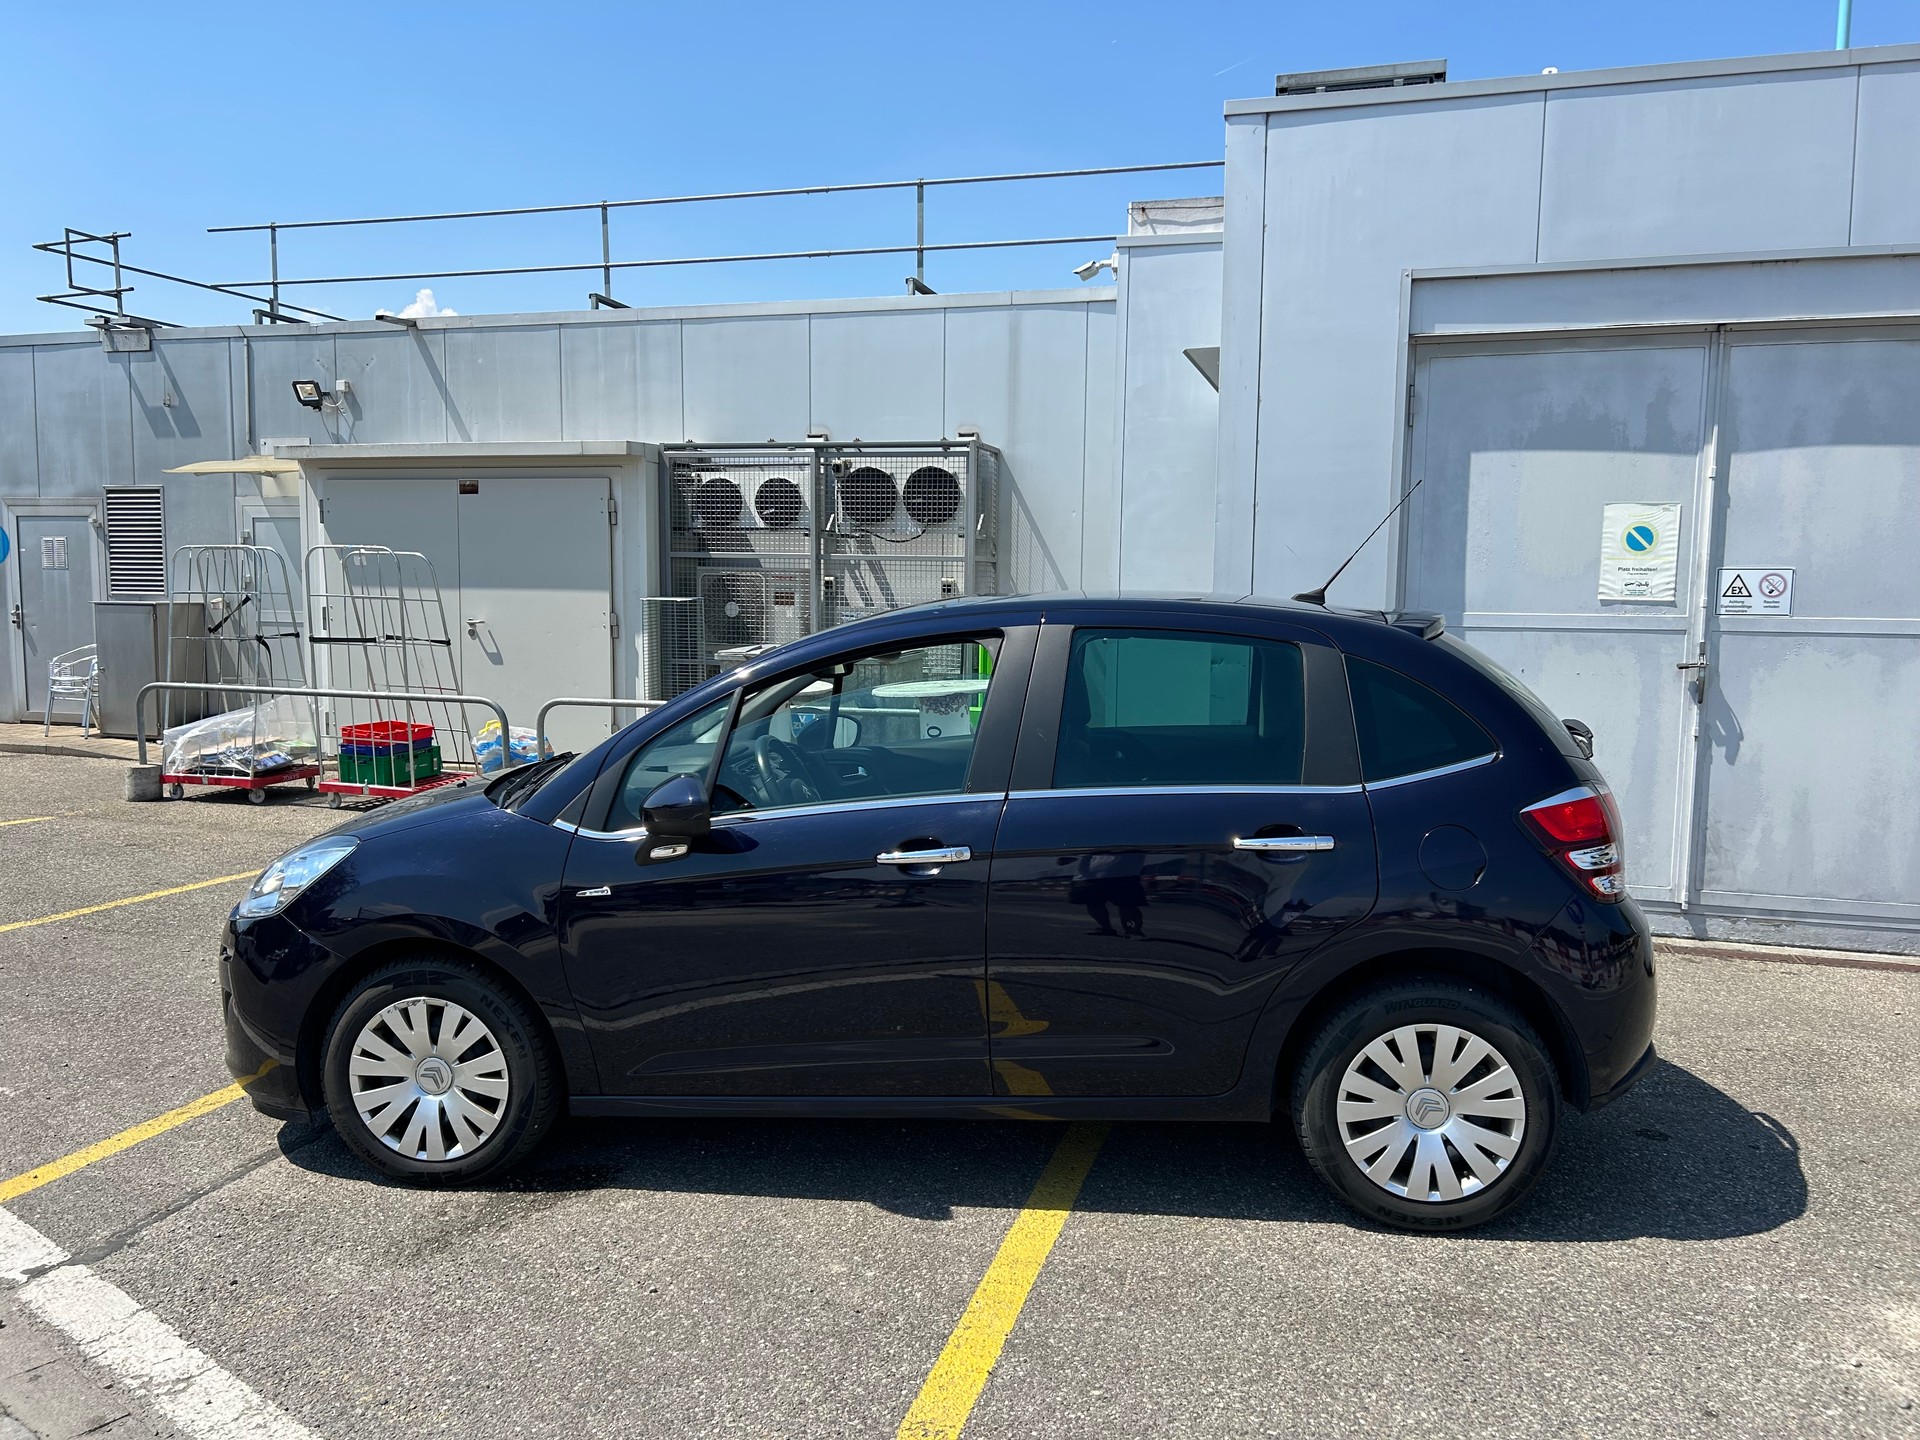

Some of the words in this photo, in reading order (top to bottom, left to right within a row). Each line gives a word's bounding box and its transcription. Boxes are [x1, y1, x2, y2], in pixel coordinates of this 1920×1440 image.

[1731, 586, 1744, 595] EX
[1384, 997, 1460, 1015] WINGUARD
[479, 994, 529, 1059] NEXEN
[1375, 1204, 1463, 1226] NEXEN
